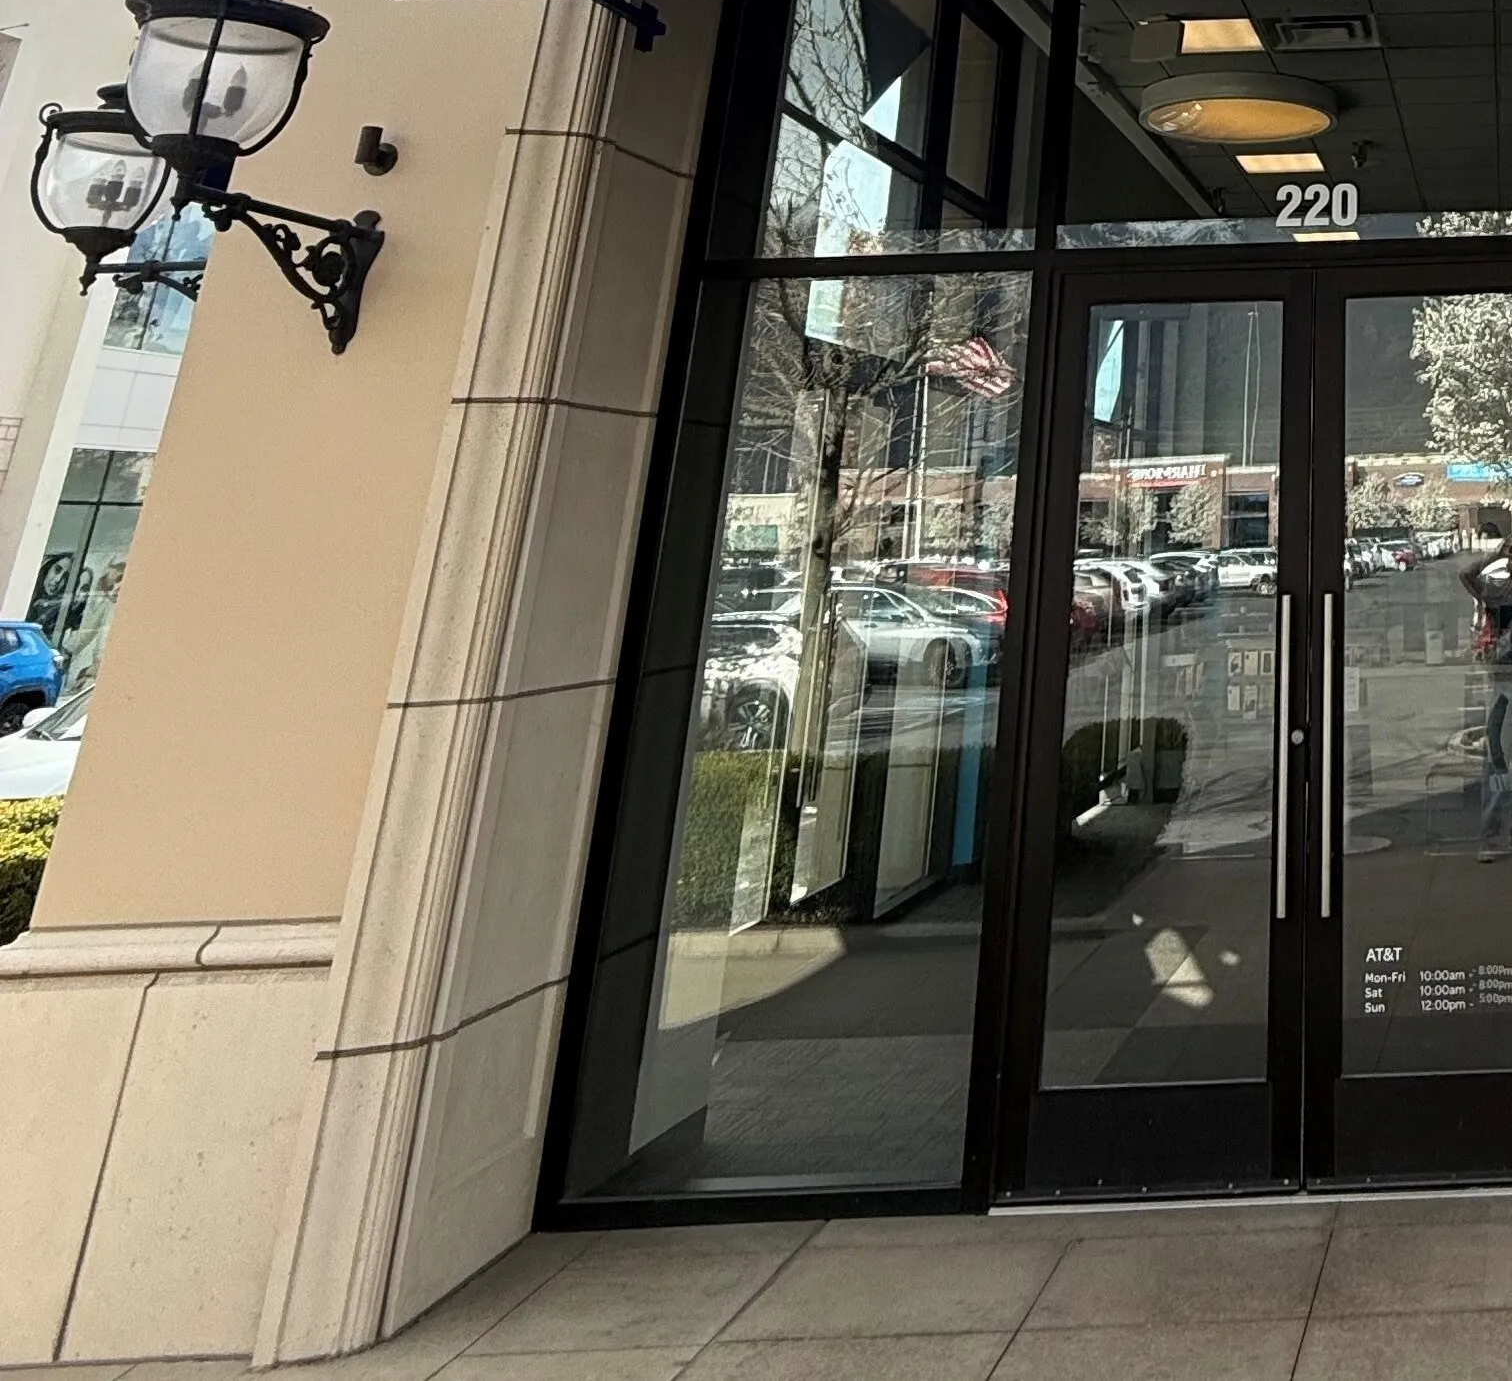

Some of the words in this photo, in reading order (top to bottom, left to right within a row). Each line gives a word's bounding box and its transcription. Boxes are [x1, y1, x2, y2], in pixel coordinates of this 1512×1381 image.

[1275, 183, 1358, 227] 220
[1365, 947, 1403, 962] AT&T
[1364, 971, 1406, 984] Mon-Fri
[1419, 970, 1466, 982] 10:00am
[1364, 987, 1383, 998] Sat
[1419, 985, 1466, 996] 10:00am
[1364, 1002, 1385, 1013] Sun
[1421, 999, 1467, 1012] 12:00pm
